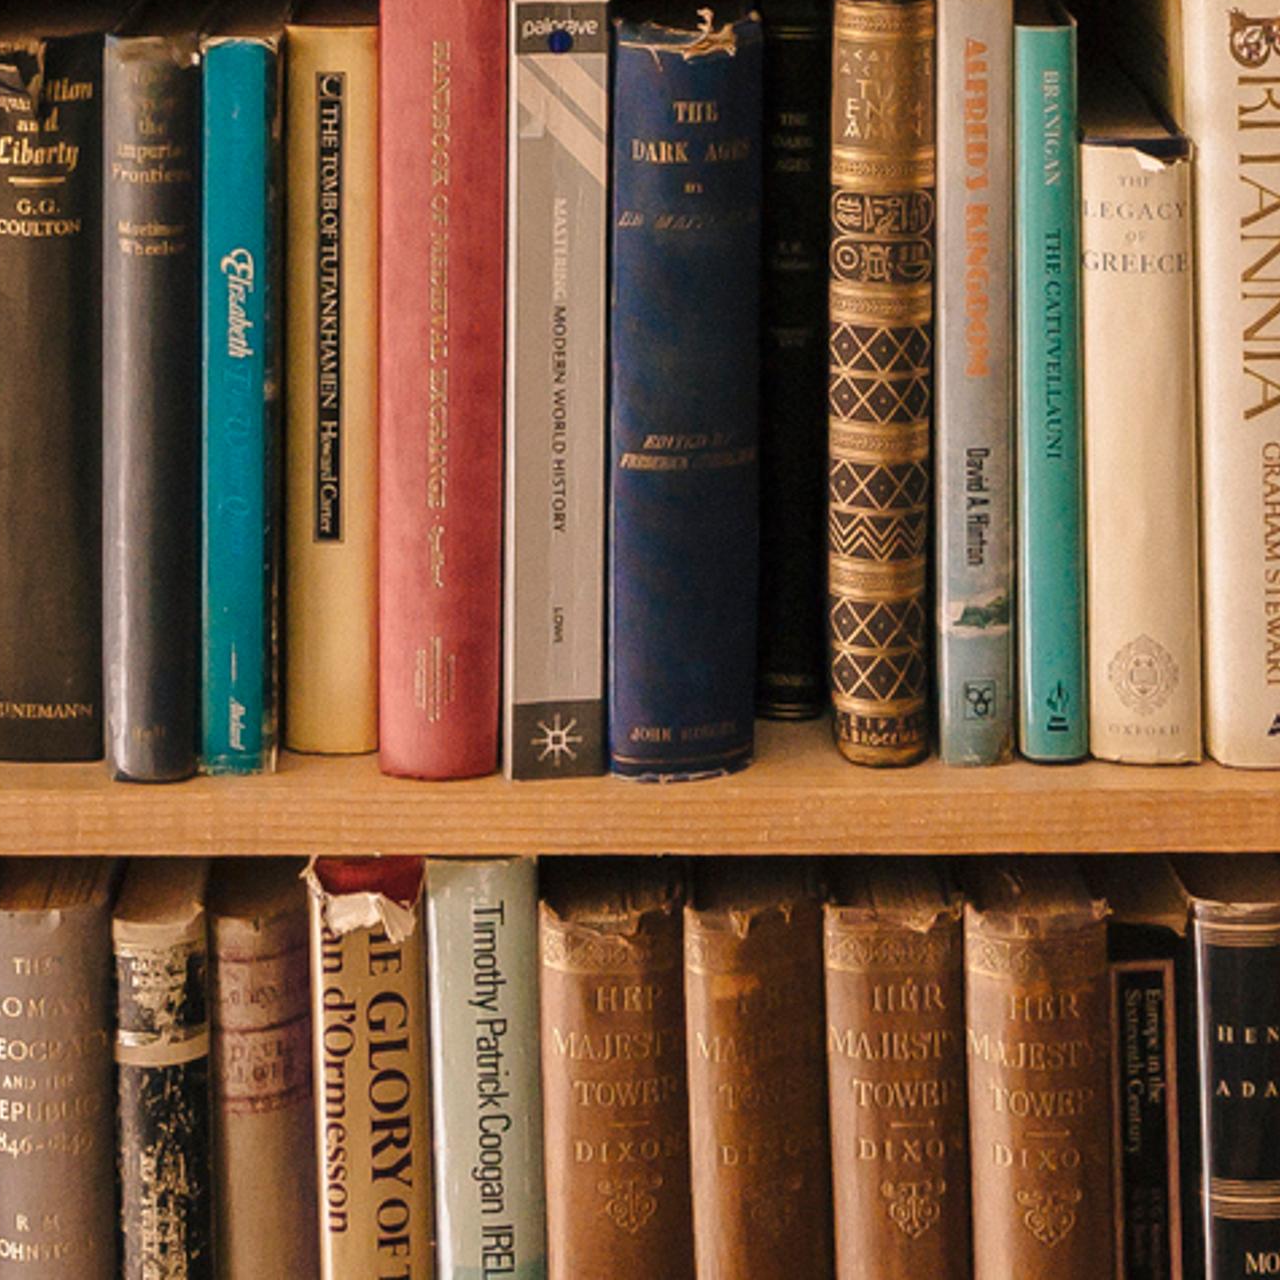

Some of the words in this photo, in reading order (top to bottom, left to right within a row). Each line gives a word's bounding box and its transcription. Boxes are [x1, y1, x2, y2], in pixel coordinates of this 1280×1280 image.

[551, 304, 568, 381] MODERN
[551, 389, 568, 453] WORLD
[550, 460, 567, 533] HISTORY
[469, 902, 505, 1012] Timothy
[365, 990, 411, 1189] GLORY
[476, 1020, 508, 1108] Patrick
[472, 1114, 509, 1214] Coogan
